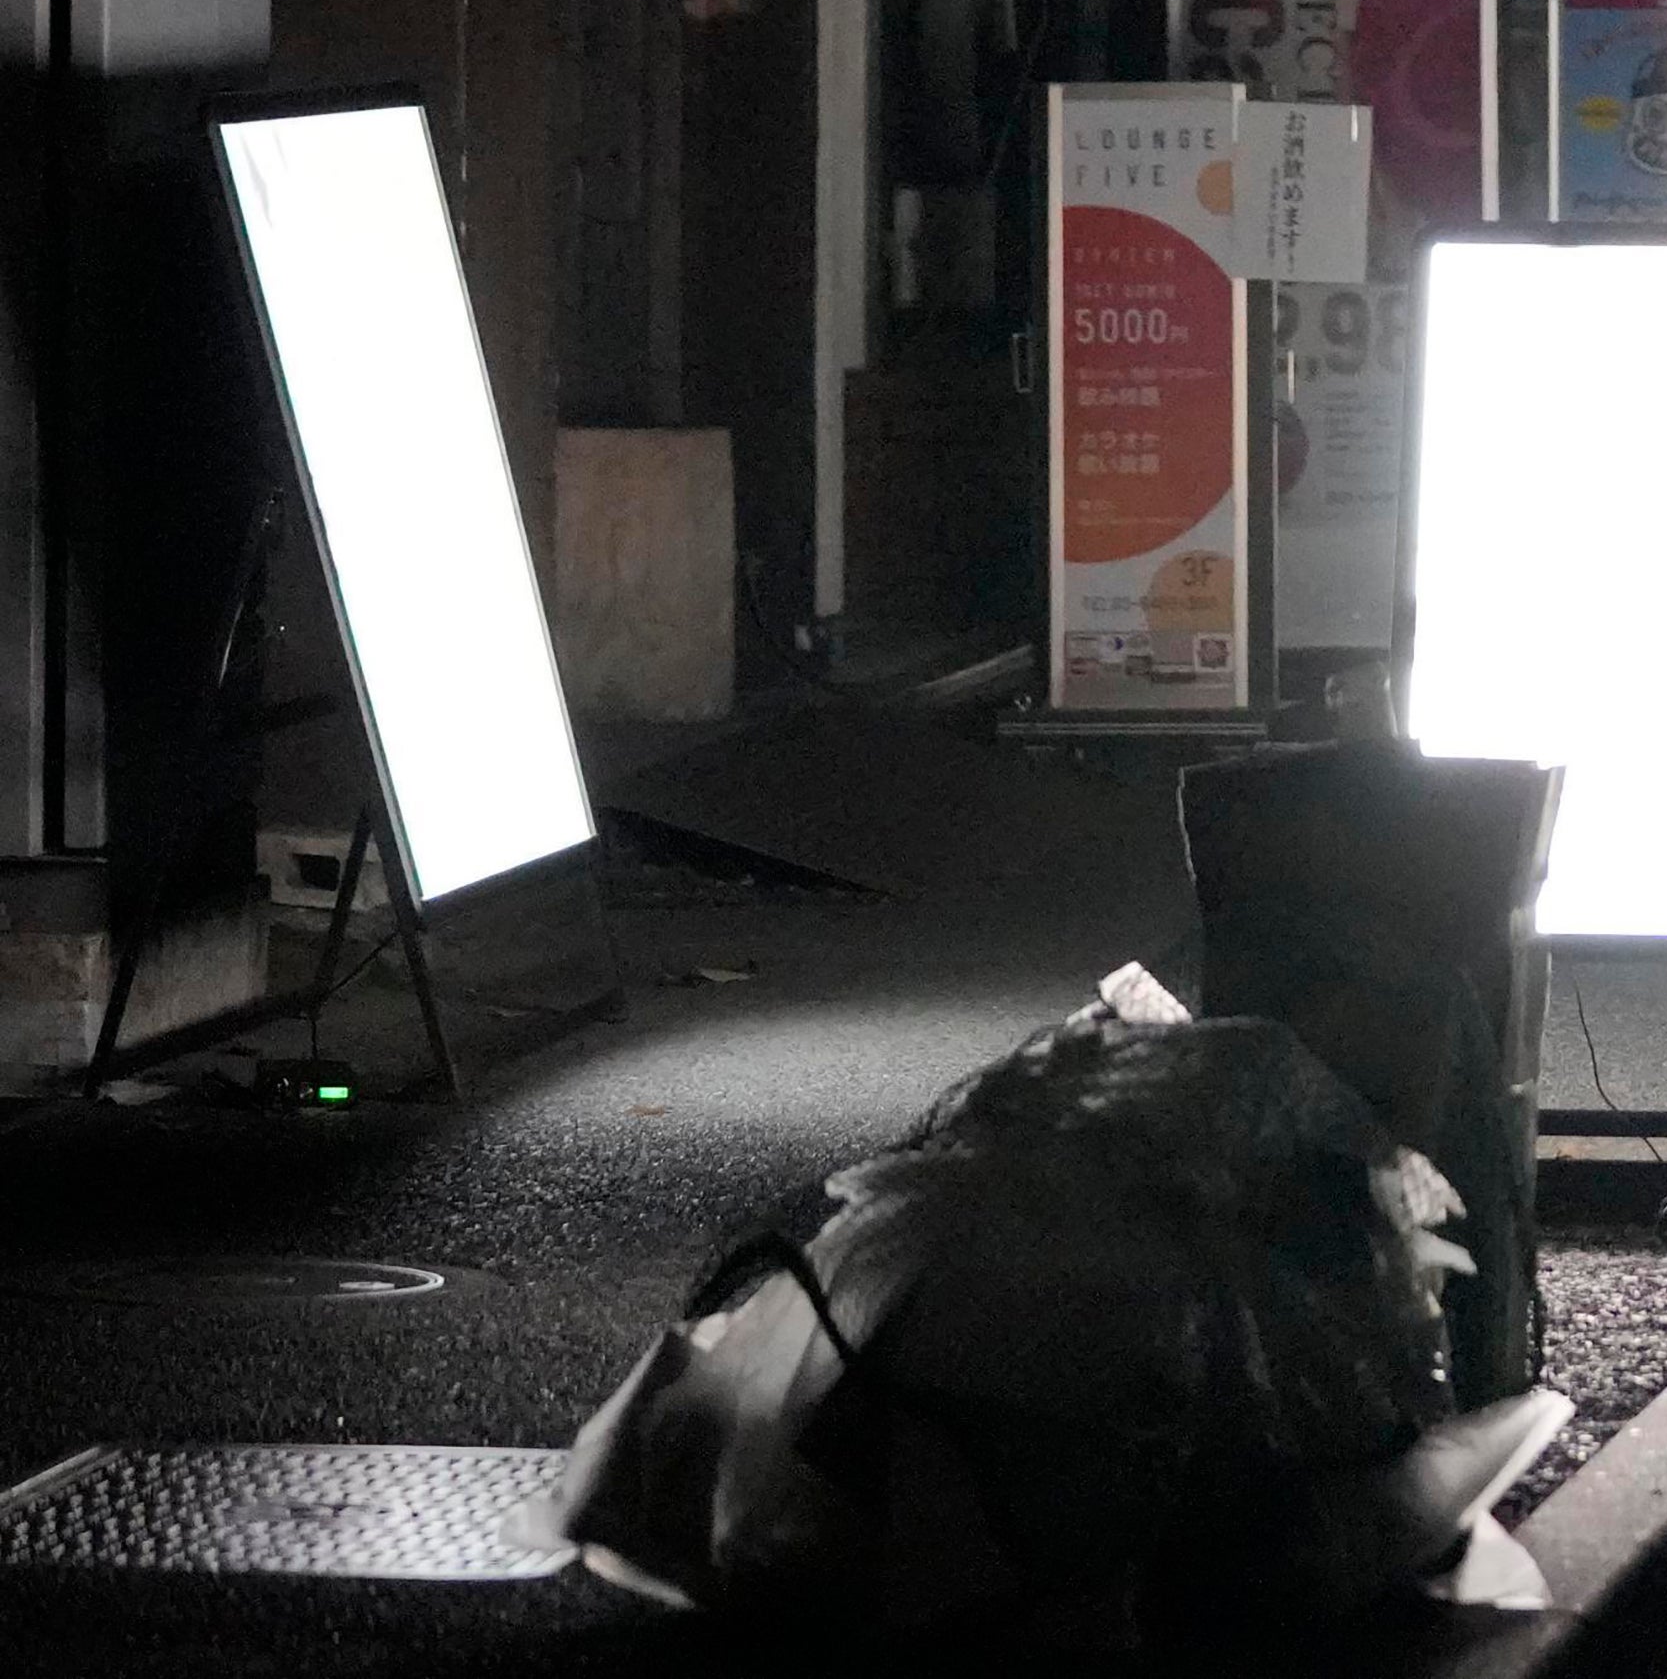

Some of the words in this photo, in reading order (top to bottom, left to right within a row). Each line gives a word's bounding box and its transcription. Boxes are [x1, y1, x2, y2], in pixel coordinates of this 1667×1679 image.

[1075, 128, 1217, 150] LOUNGE
[1076, 165, 1166, 187] FIVE
[1182, 556, 1213, 587] 3F
